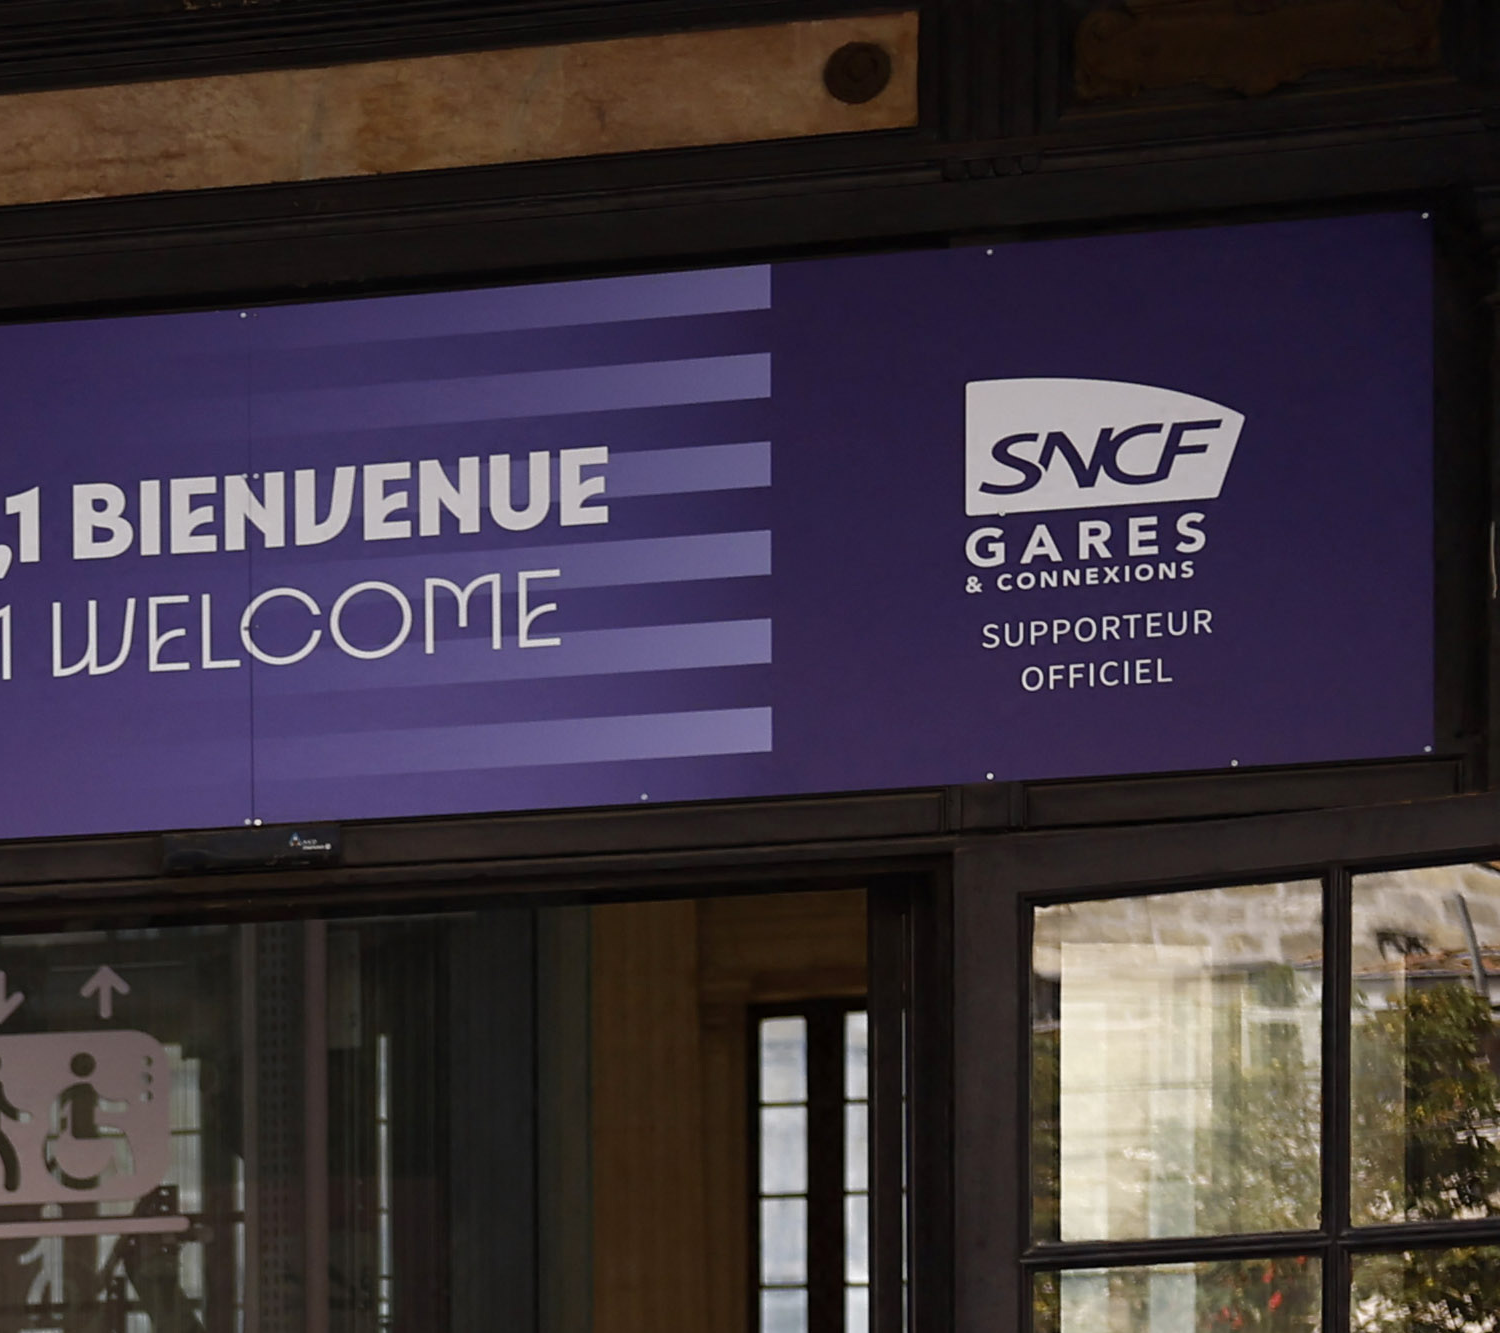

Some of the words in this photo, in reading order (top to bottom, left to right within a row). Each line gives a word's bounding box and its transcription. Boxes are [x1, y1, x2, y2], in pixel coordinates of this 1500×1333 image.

[979, 419, 1223, 495] SNCF
[73, 445, 610, 560] BIENVENUE
[965, 512, 1206, 567] GARES
[965, 576, 983, 593] &
[996, 560, 1195, 591] CONNEXIONS
[51, 569, 562, 678] WELCOME
[982, 609, 1213, 649] SUPPORTEUR
[1021, 658, 1173, 692] OFFICIEL
